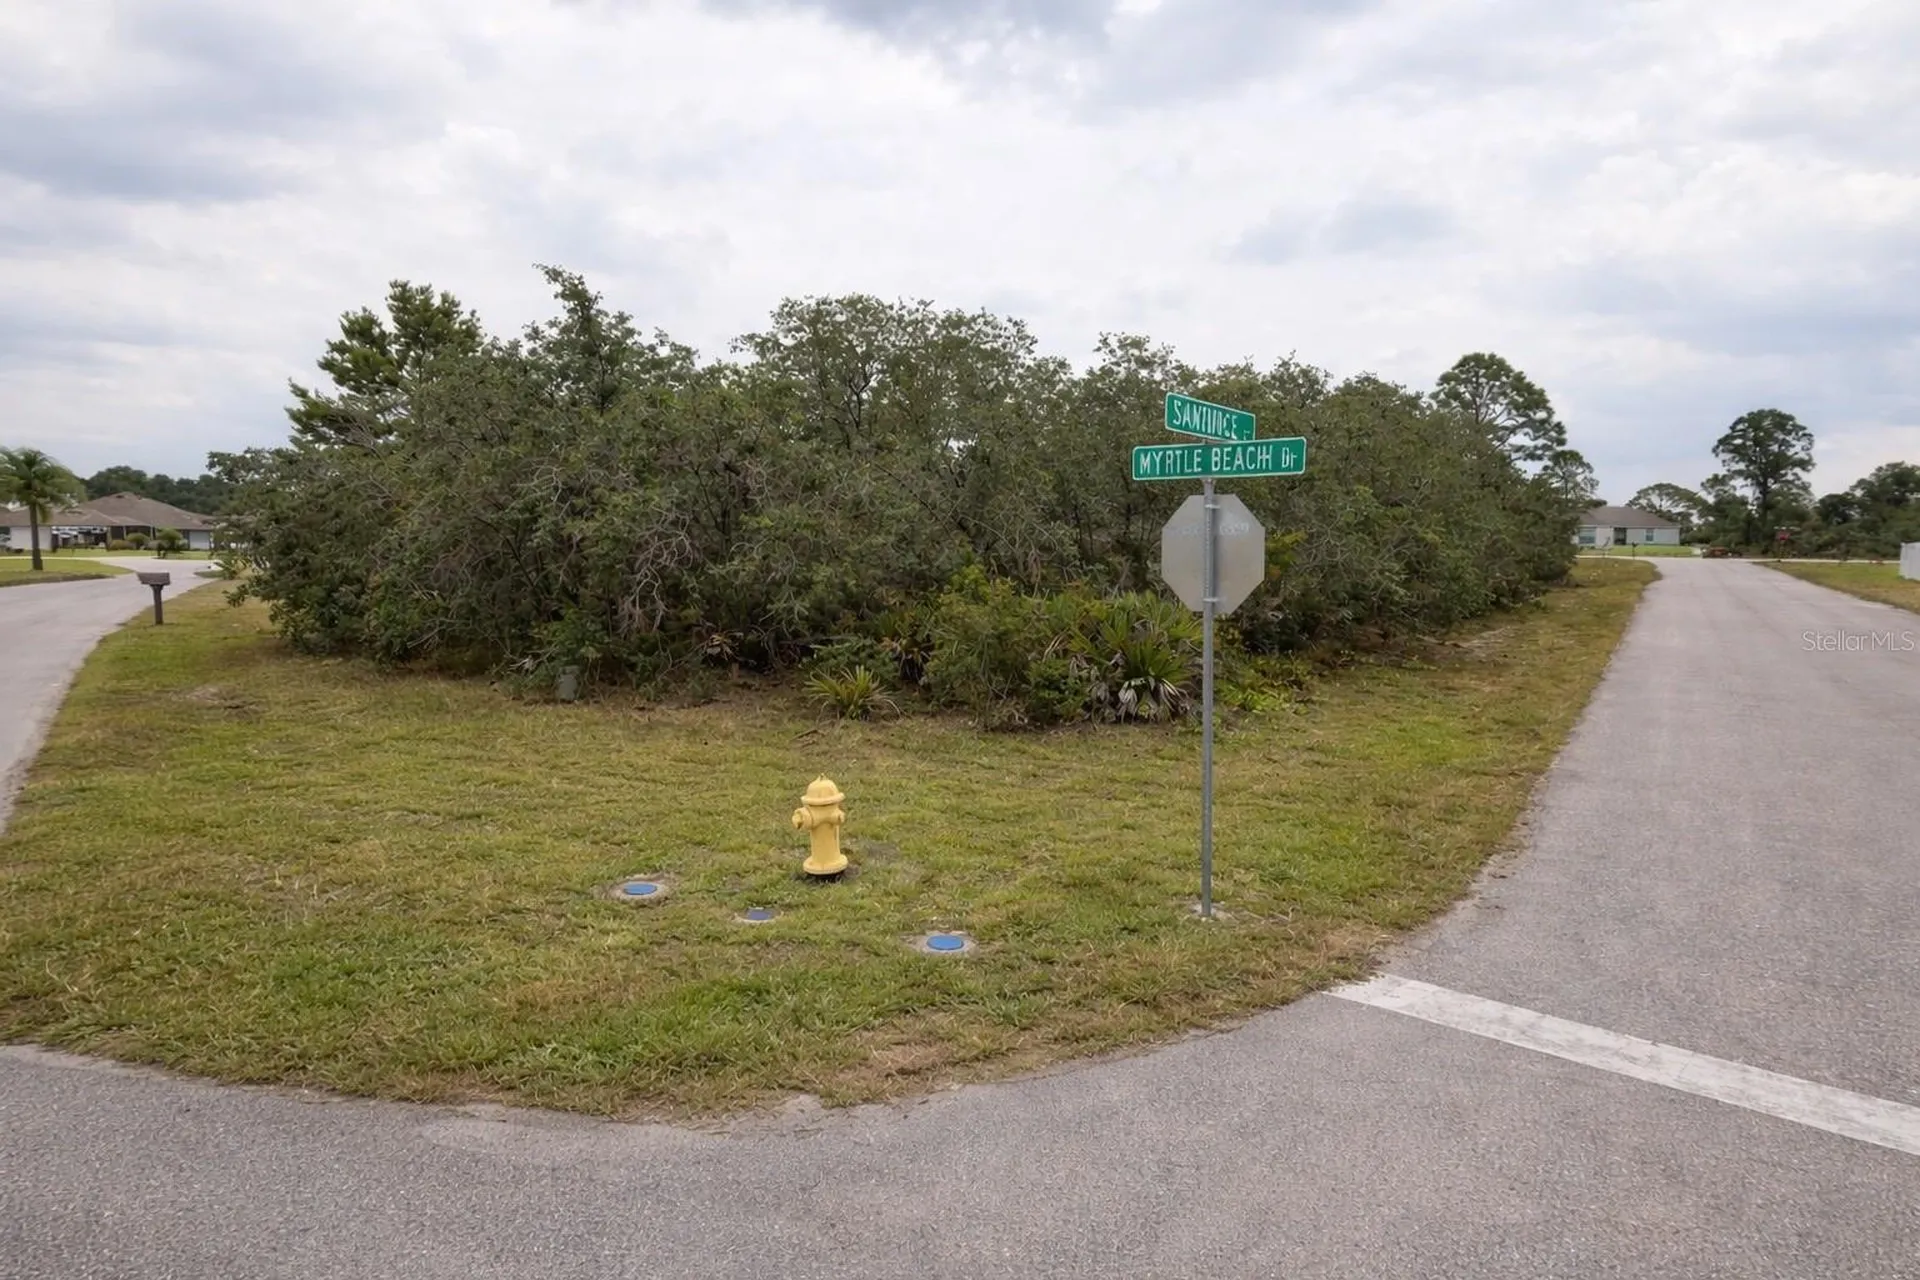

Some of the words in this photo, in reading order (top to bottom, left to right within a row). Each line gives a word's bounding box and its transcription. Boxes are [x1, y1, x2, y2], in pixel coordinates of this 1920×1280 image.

[1139, 450, 1203, 475] MYRTLE
[1211, 445, 1273, 472] BEACH
[1281, 447, 1298, 469] Dr
